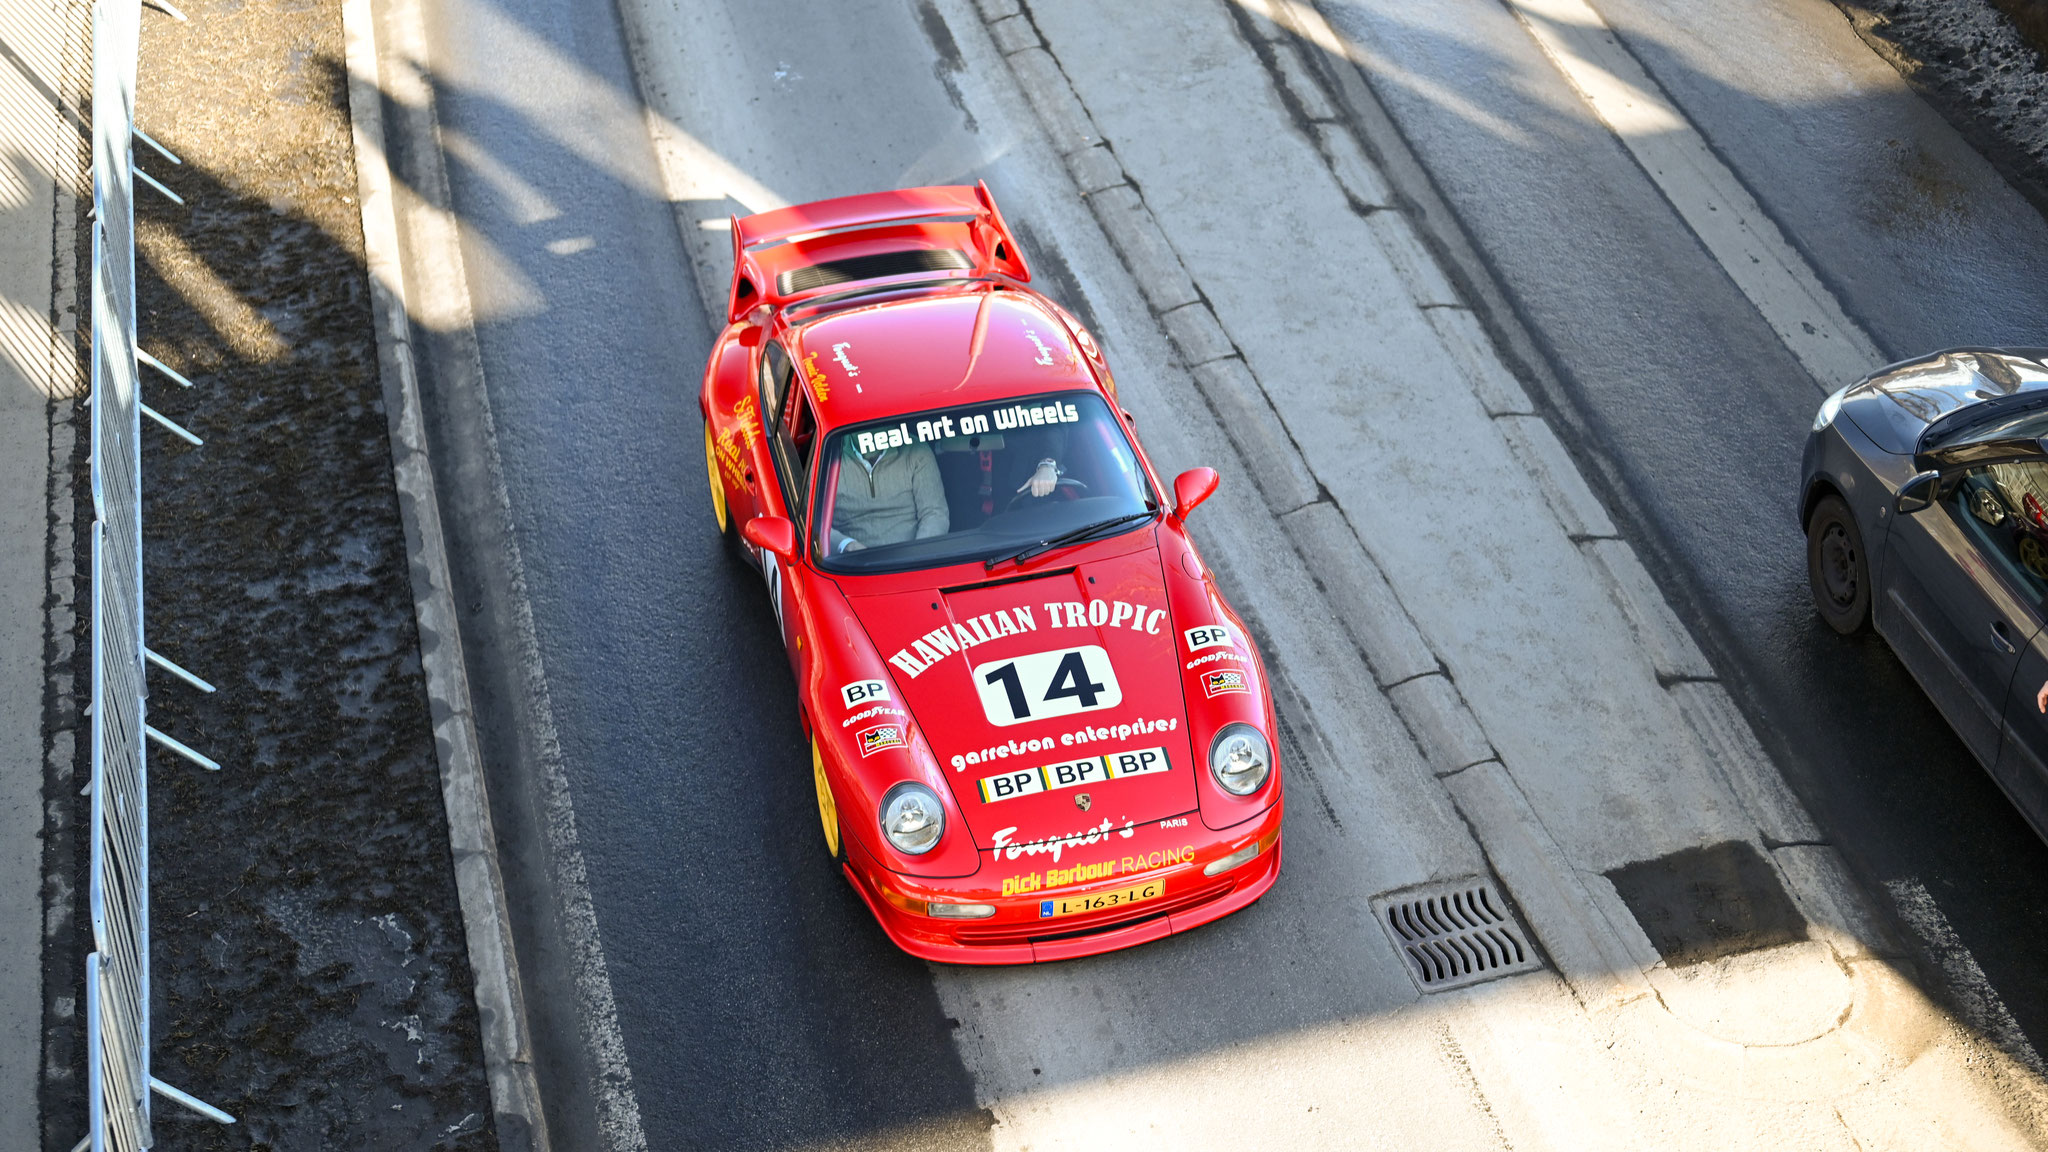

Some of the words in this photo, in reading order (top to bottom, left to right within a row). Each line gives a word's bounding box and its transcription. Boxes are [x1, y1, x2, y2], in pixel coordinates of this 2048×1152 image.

[717, 427, 741, 462] Real
[857, 422, 912, 454] Real
[916, 416, 955, 443] Art
[959, 414, 989, 435] on
[993, 401, 1079, 430] Wheels
[888, 605, 1037, 679] HAWAIIAN
[1044, 599, 1166, 635] TROPIC
[1186, 651, 1248, 669] GOODYEAR
[1190, 628, 1226, 646] BP
[846, 683, 883, 703] BP
[985, 651, 1105, 719] 14
[842, 706, 905, 728] GOODYEAR
[950, 736, 1055, 772] garretson
[1060, 717, 1178, 745] enterprises
[993, 773, 1032, 797] BP
[1055, 761, 1094, 785] BP
[1119, 751, 1157, 774] BP
[992, 815, 1134, 863] Fouquet's
[1160, 818, 1188, 829] PARIS
[1002, 872, 1041, 897] Dick
[1046, 860, 1116, 888] Barbour
[1121, 845, 1195, 874] RACING
[1062, 886, 1155, 914] L-163-LG
